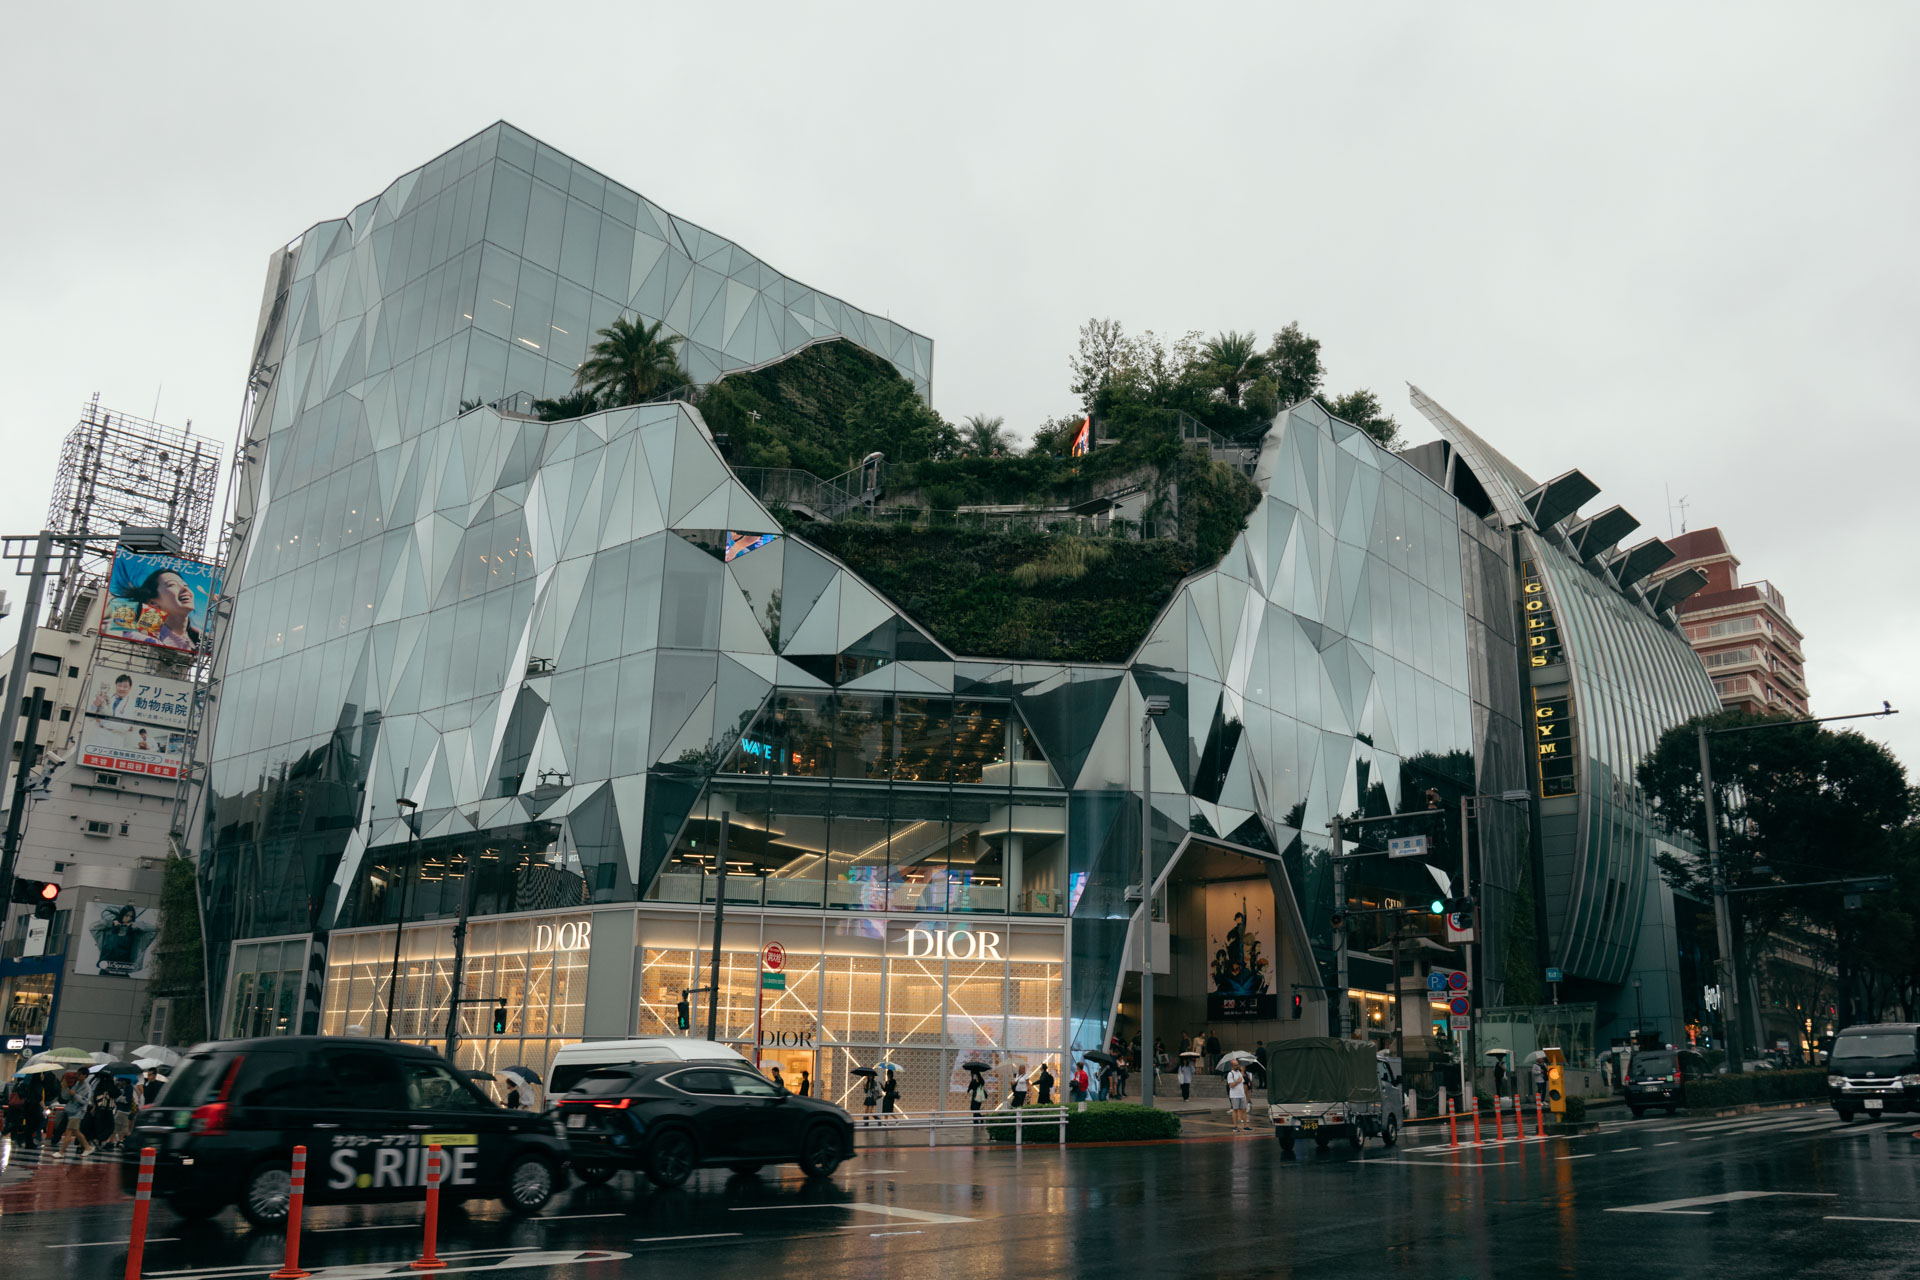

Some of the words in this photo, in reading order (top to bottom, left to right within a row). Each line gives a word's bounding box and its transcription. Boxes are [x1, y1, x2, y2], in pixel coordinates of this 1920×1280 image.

[1524, 582, 1548, 668] GOLD'S
[1536, 707, 1557, 754] GYM
[138, 685, 190, 703] アリーズ
[135, 697, 188, 717] 動物病院
[904, 928, 1003, 960] DIOR
[760, 1030, 813, 1048] DIOR
